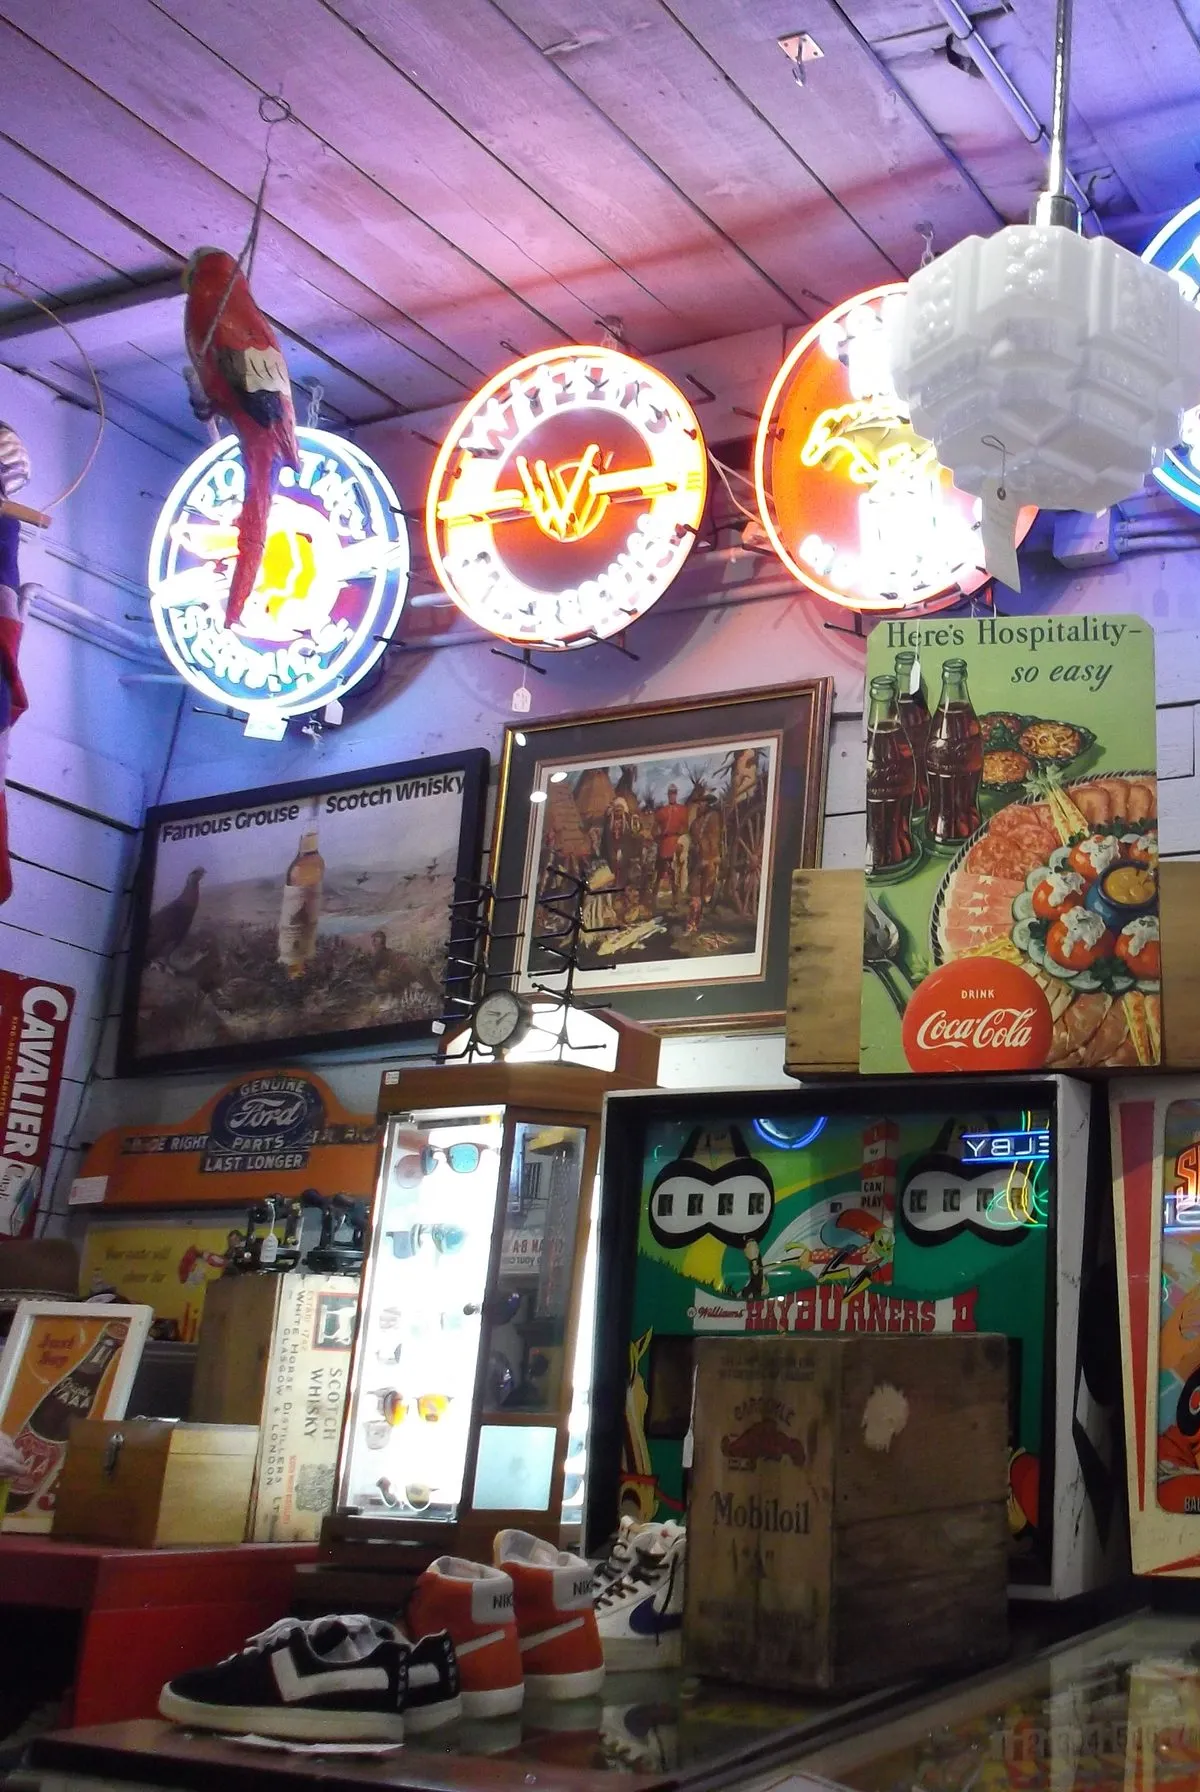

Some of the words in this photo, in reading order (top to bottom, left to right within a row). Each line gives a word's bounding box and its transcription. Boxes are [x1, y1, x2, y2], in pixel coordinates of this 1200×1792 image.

[887, 622, 965, 649] Here's
[1010, 663, 1040, 684] so
[1049, 661, 1114, 692] easy
[161, 815, 231, 843] Famous
[234, 802, 300, 830] Grouse
[325, 785, 392, 814] Scotch
[395, 771, 466, 803] Whisky
[961, 988, 996, 1000] DRINK
[916, 1007, 1038, 1051] Coca-Cola
[3, 985, 69, 1157] CAVALIER
[240, 1079, 307, 1096] GENUINE
[229, 1098, 302, 1129] Ford
[170, 1135, 209, 1150] RIGHT
[204, 1156, 242, 1172] LAST
[247, 1154, 303, 1169] LONGER
[231, 1135, 285, 1150] PARTS
[861, 1195, 881, 1208] PLAY
[863, 1181, 882, 1193] CAN
[293, 1289, 306, 1335] WHITE
[744, 1283, 936, 1333] HAYBURNERS
[276, 1328, 291, 1396] GLASGOW
[285, 1344, 299, 1392] HORSE
[304, 1367, 324, 1438] WHISKY
[323, 1367, 343, 1440] SCOTCH
[266, 1424, 279, 1485] LONDON
[711, 1490, 811, 1535] Mobiloil
